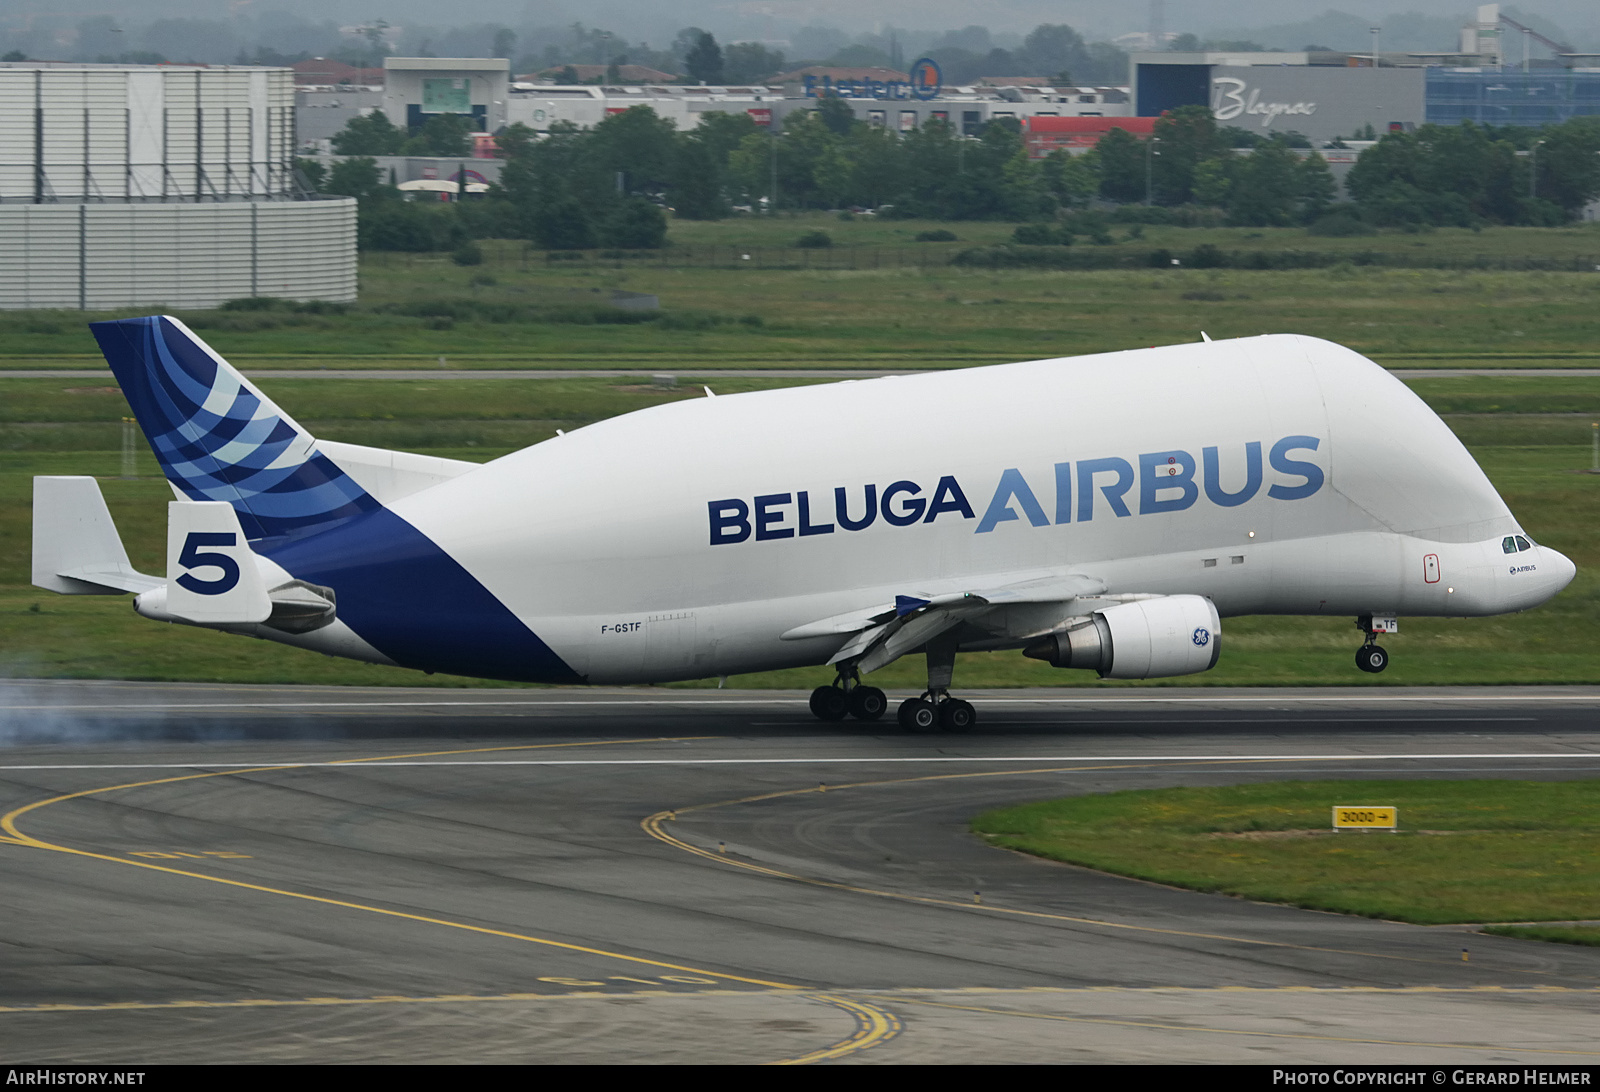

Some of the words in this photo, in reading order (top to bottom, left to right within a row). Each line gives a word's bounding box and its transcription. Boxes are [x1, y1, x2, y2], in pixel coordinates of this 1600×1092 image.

[1212, 77, 1317, 127] Blagnac
[707, 475, 976, 546] BELUGA
[974, 435, 1325, 534] AIRBUS
[175, 532, 240, 596] 5
[1516, 564, 1537, 573] AIRBUS
[601, 621, 642, 634] F-GSTF
[1383, 619, 1397, 630] TF
[1341, 811, 1376, 823] 3000
